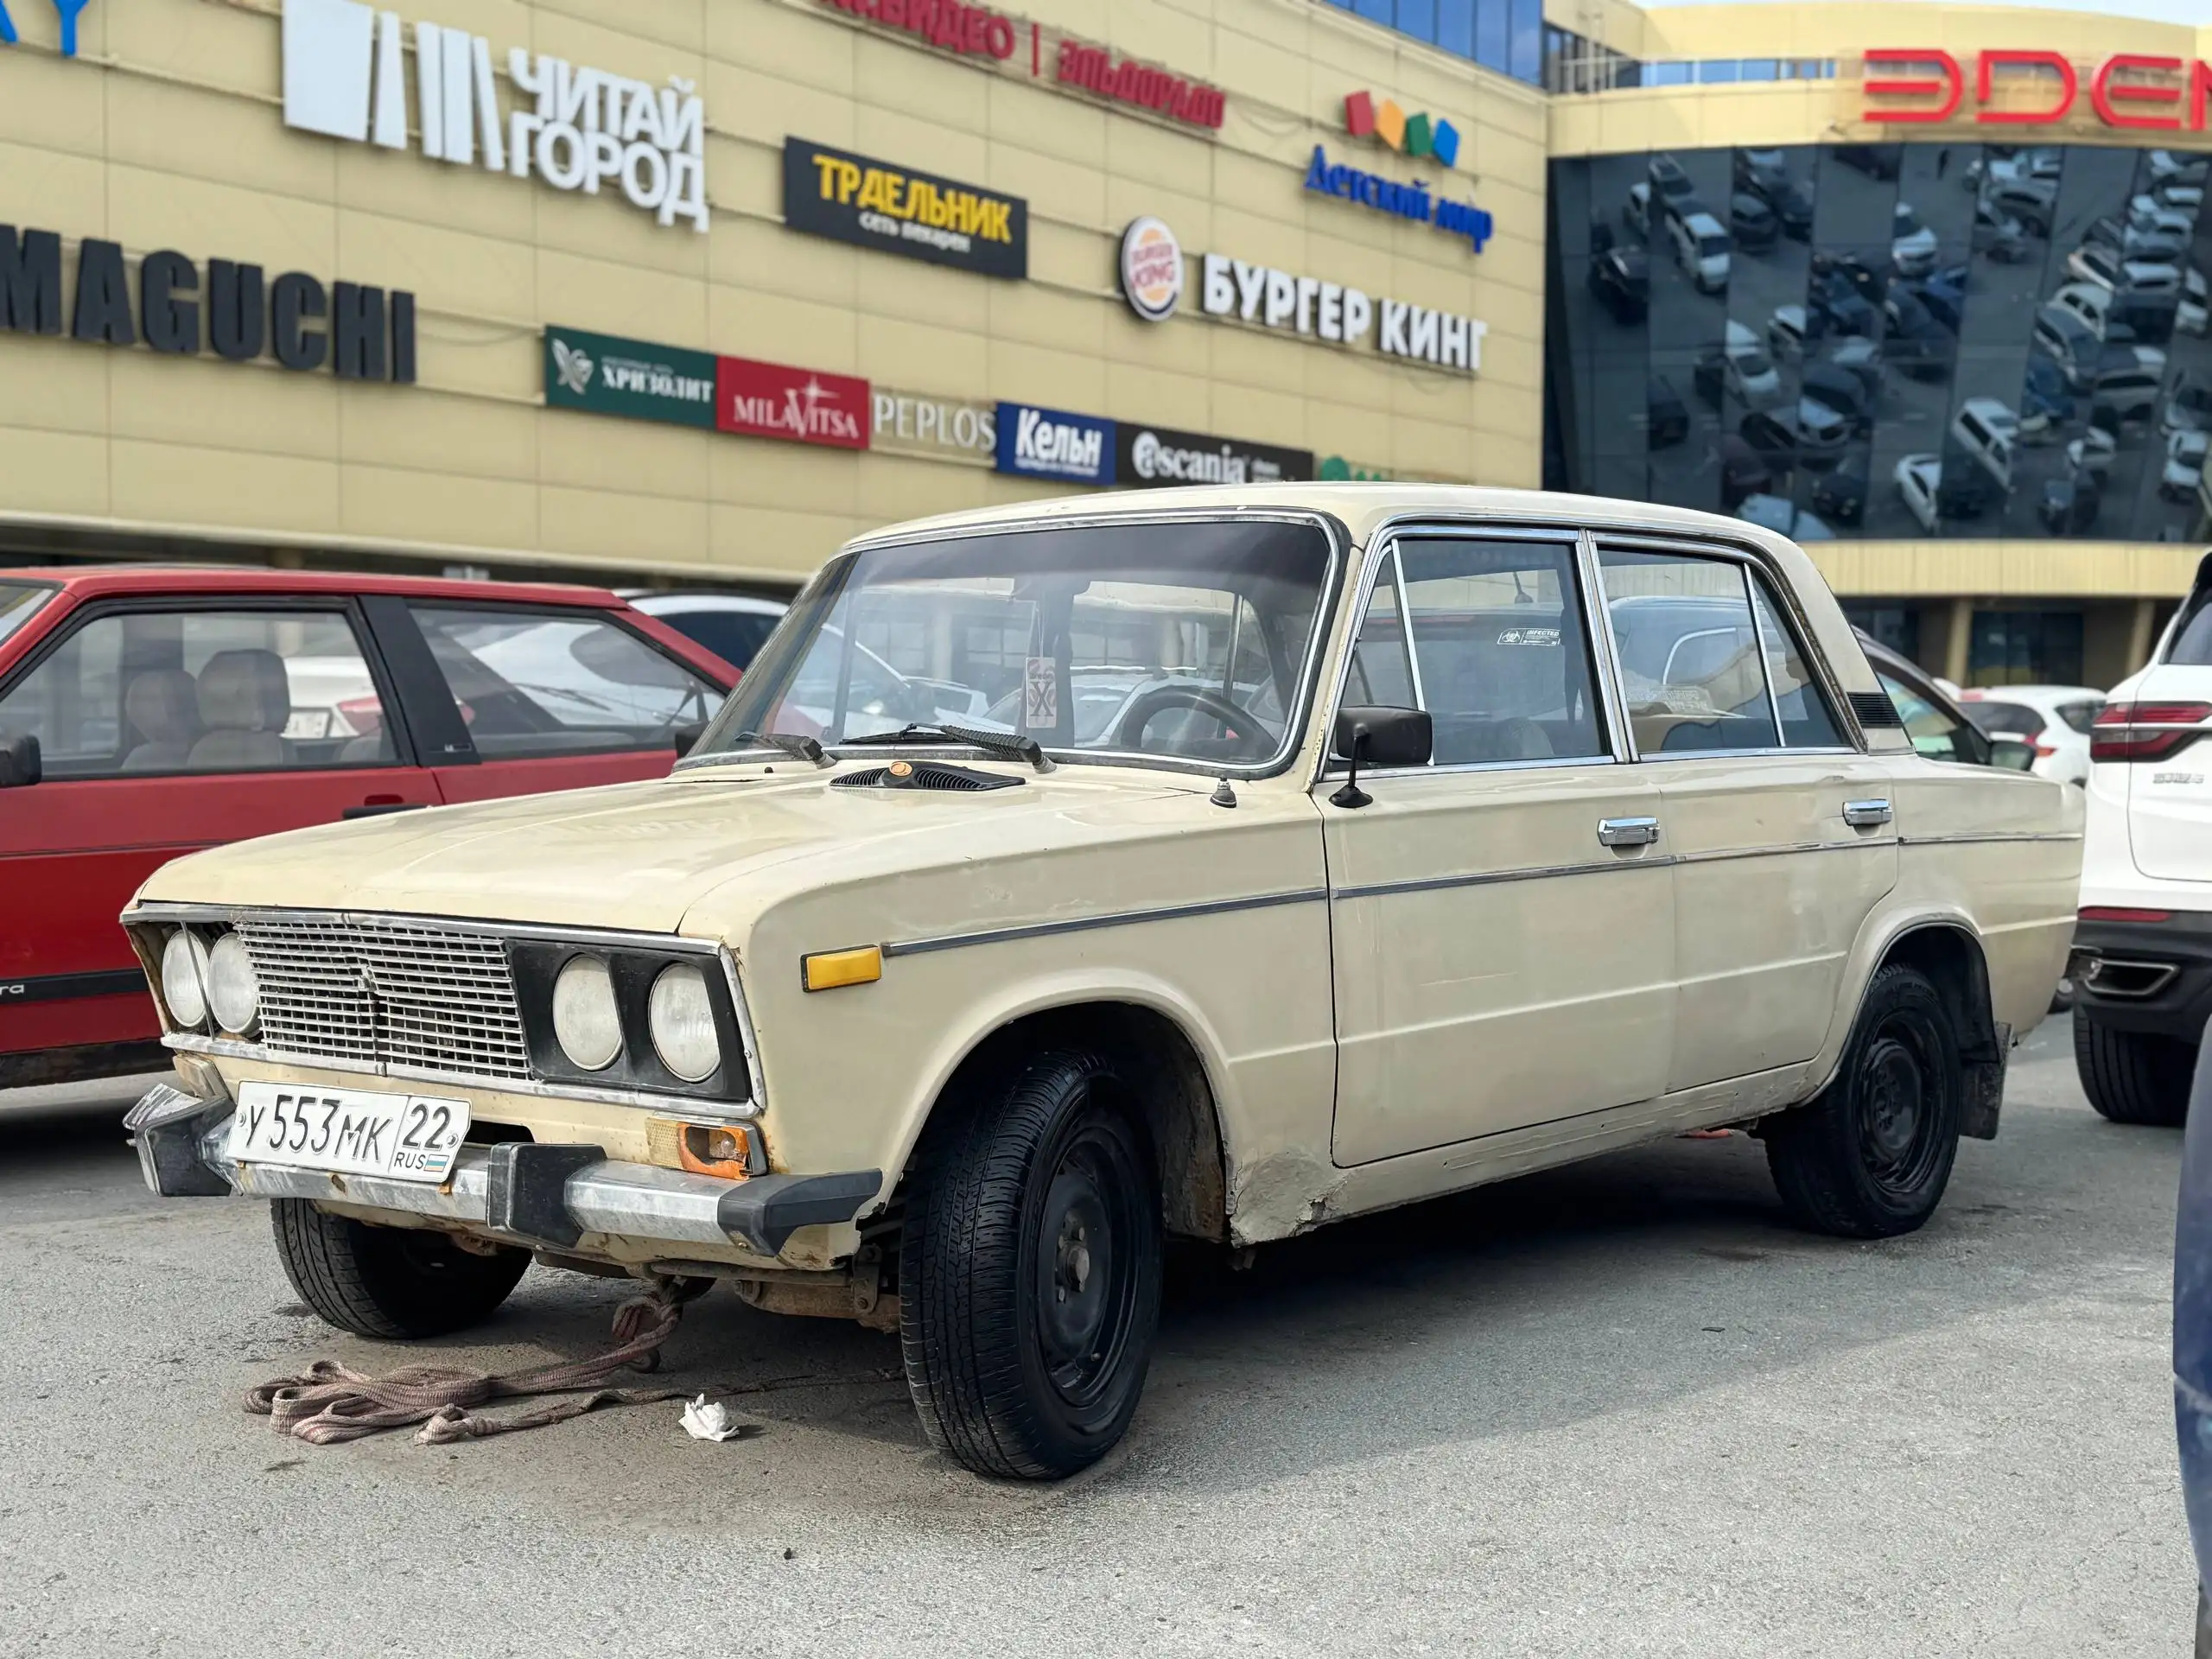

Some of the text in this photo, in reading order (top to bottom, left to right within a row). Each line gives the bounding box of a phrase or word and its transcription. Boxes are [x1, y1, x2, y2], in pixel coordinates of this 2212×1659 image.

[508, 47, 704, 157] ЧИТАЙ
[1058, 40, 1224, 130] ЭЛЬДОРАДО
[510, 111, 709, 232] ГОРОД
[812, 154, 1012, 244] ТРДЕЛЬНИК
[1303, 143, 1492, 254] Детский мир
[1204, 252, 1488, 371] БУРГЕР КИНГ
[872, 394, 997, 453] PEPLOS
[1015, 408, 1103, 467] Кельн
[394, 1152, 426, 1170] RUS
[403, 1103, 451, 1150] 22
